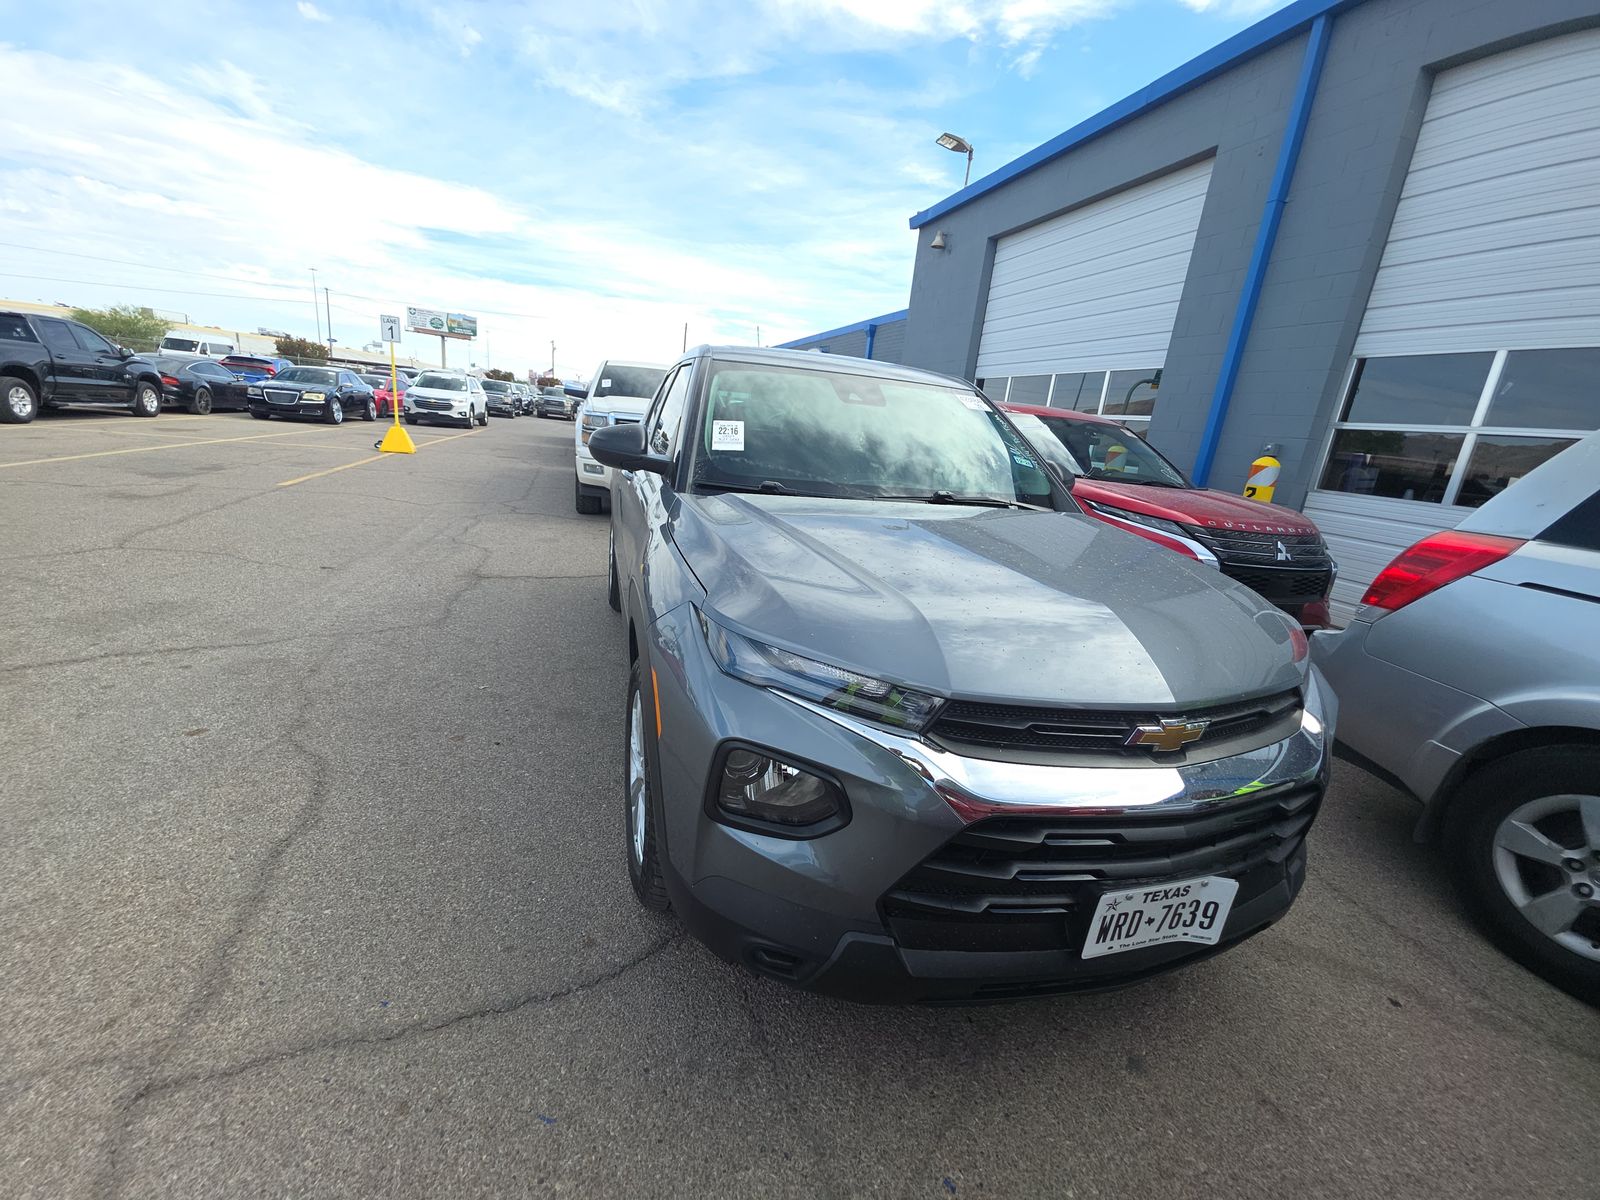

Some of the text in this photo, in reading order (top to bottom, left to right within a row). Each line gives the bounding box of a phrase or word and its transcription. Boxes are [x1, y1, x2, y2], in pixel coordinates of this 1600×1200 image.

[382, 317, 397, 325] LANE
[387, 325, 394, 339] 1
[718, 426, 739, 435] 22:16
[1142, 885, 1191, 904] TEXAS
[1095, 899, 1220, 945] WRD 7639
